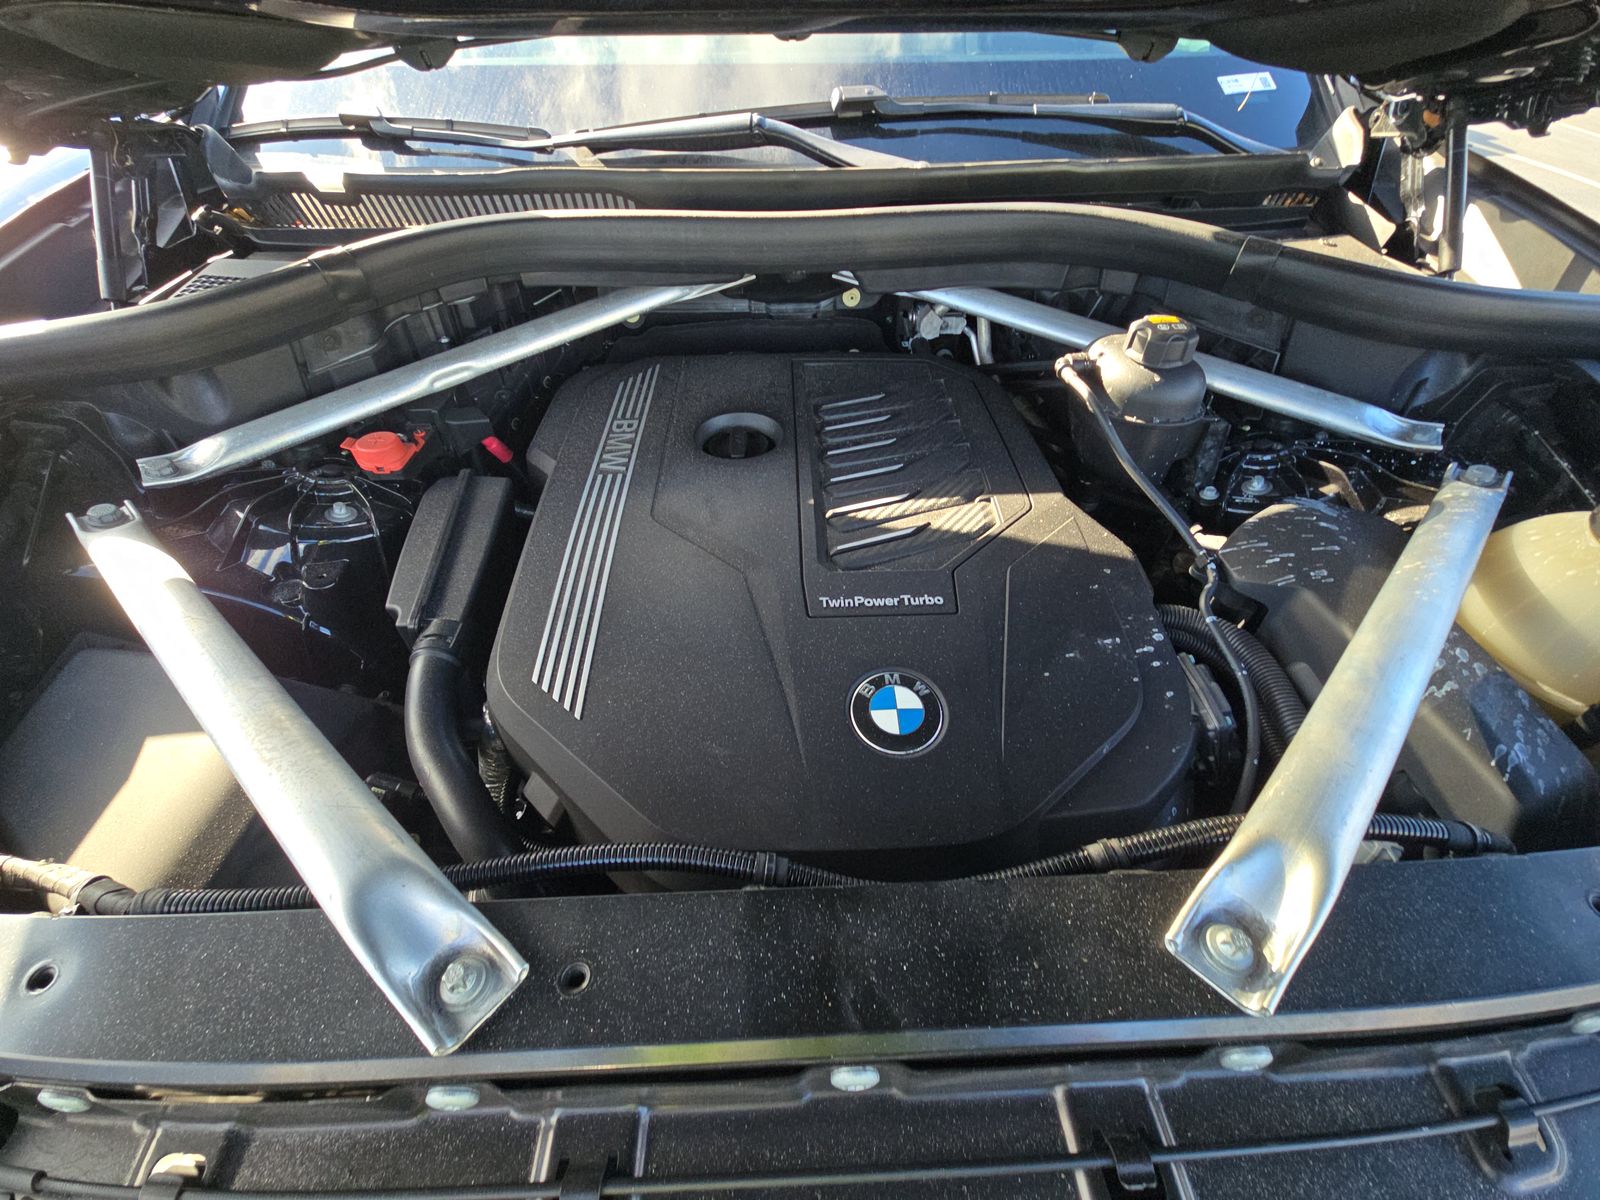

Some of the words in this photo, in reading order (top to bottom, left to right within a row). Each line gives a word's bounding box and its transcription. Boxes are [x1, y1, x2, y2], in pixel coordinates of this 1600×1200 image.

[600, 420, 639, 470] BMW
[819, 595, 899, 608] TwinPower
[900, 594, 944, 606] Turbo
[859, 673, 930, 698] BMW
